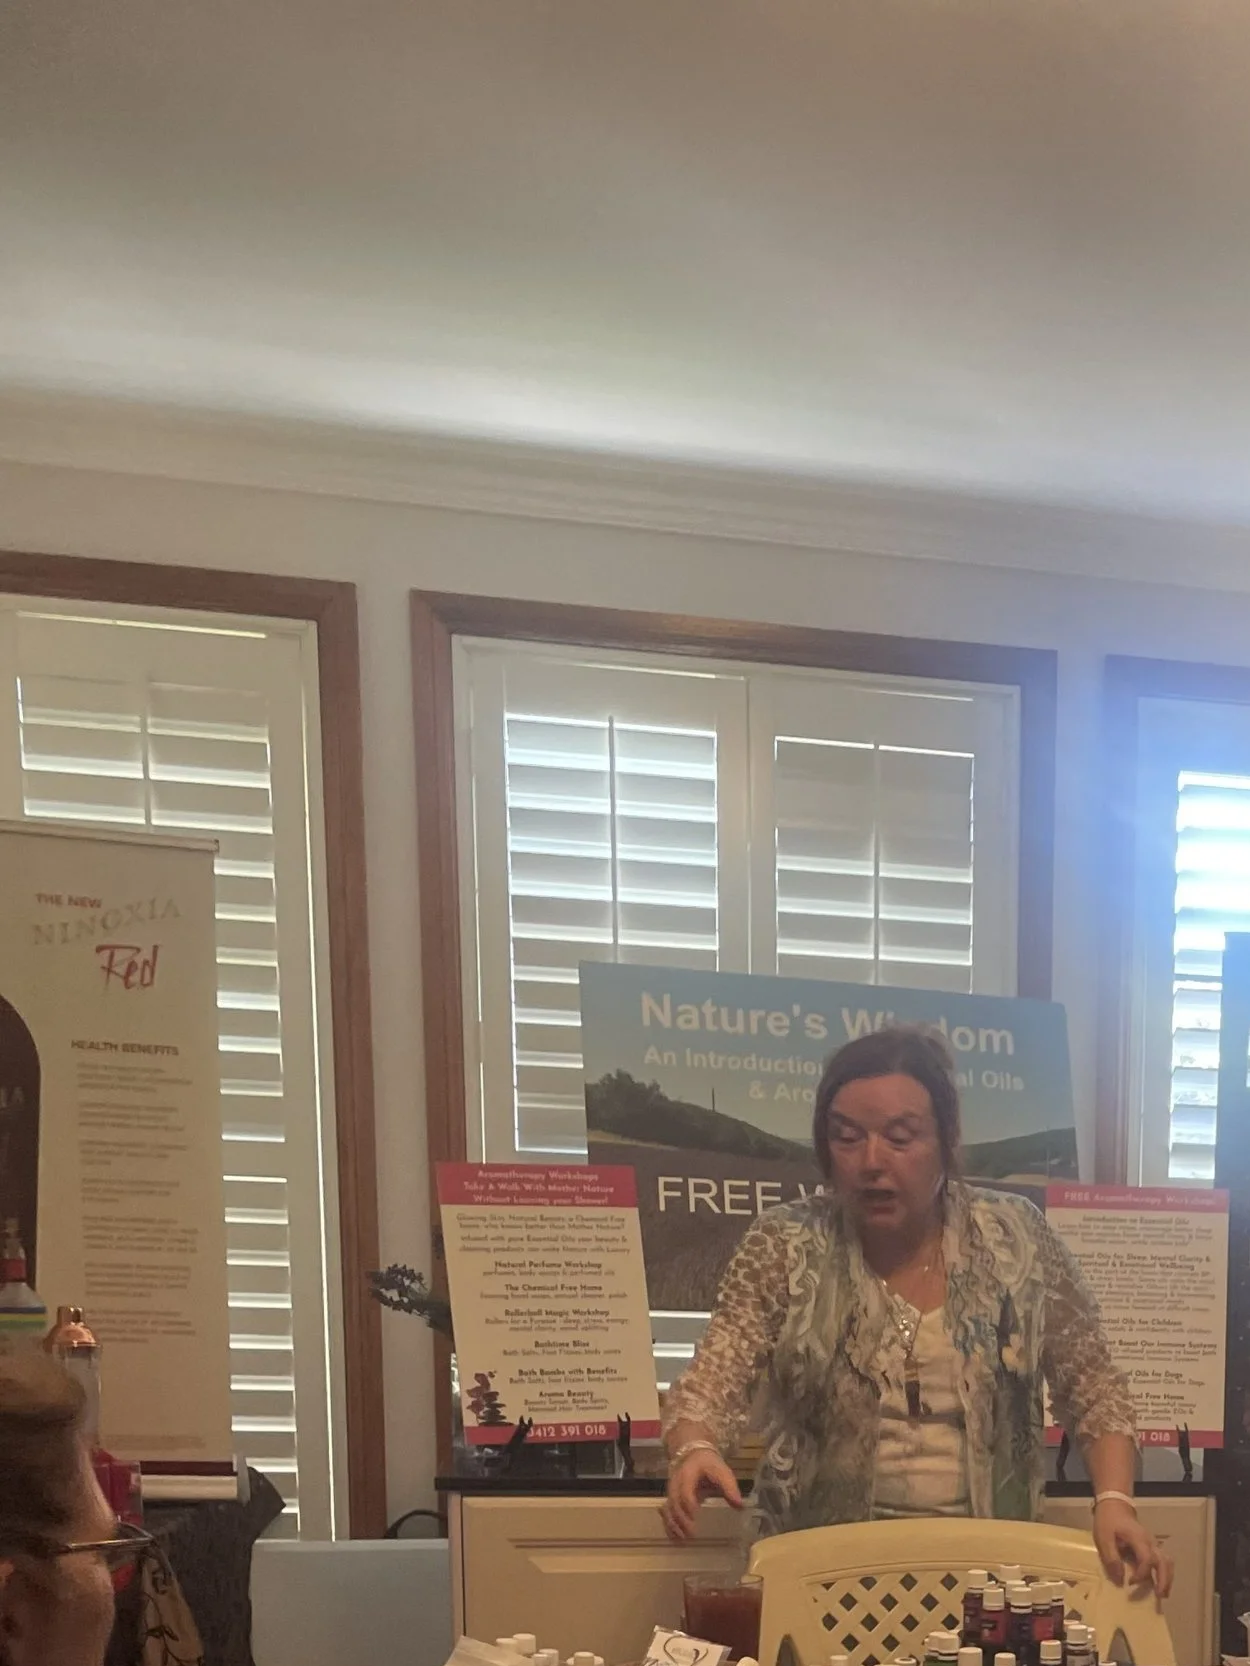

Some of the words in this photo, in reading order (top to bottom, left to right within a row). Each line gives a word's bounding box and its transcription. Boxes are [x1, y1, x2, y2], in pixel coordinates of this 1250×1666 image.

[95, 944, 159, 996] Red
[640, 990, 829, 1041] Nature's
[71, 1039, 118, 1051] HEALTH
[122, 1042, 179, 1056] BENEFITS
[644, 1045, 678, 1068] An
[980, 1070, 1025, 1092] Oils
[748, 1080, 766, 1100] &
[463, 1182, 484, 1191] Take
[498, 1183, 520, 1192] Walk
[523, 1183, 545, 1192] With
[583, 1185, 614, 1193] Nature
[657, 1175, 782, 1216] FREE
[564, 1261, 602, 1269] Workshop
[522, 1284, 558, 1292] Chemical
[561, 1284, 578, 1292] Free
[573, 1309, 610, 1318] Workshop
[587, 1367, 618, 1375] Benefits
[568, 1390, 594, 1399] Beauty
[561, 1425, 580, 1436] 391
[585, 1424, 607, 1436] 018
[1150, 1433, 1170, 1442] 018
